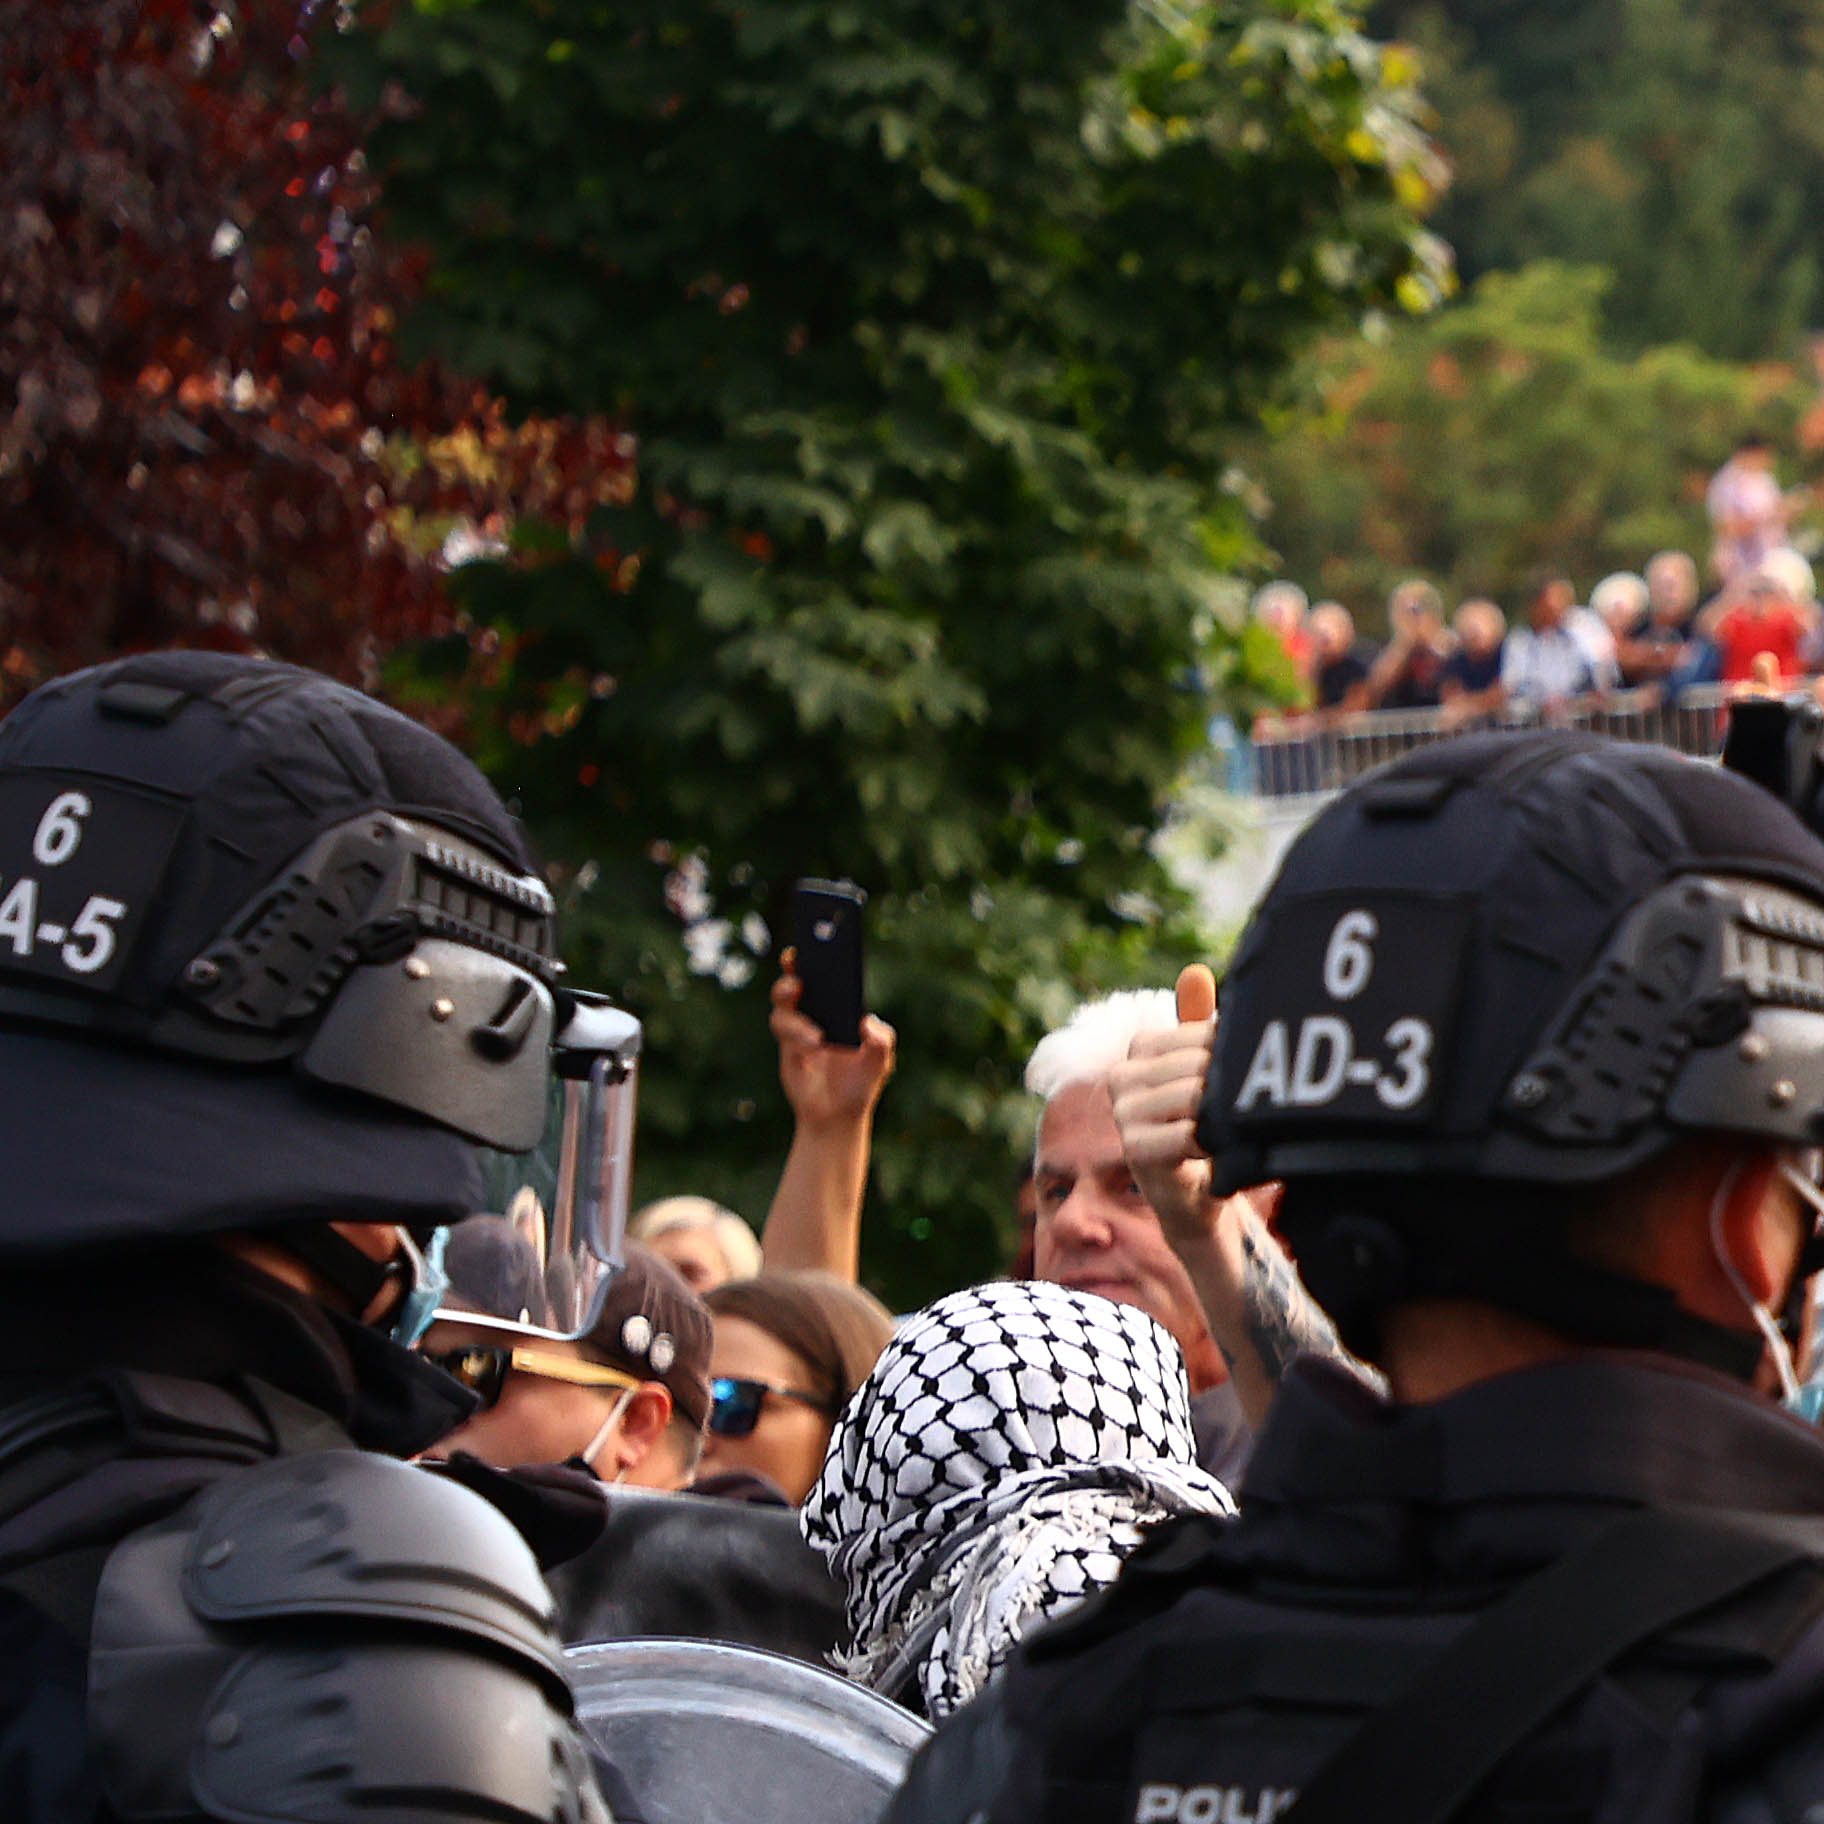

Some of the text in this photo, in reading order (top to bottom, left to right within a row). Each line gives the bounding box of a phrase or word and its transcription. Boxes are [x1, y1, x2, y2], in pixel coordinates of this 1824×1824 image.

[33, 792, 92, 866] 6
[0, 876, 127, 972] A-5
[1324, 909, 1379, 999] 6
[1234, 1013, 1434, 1111] AD-3
